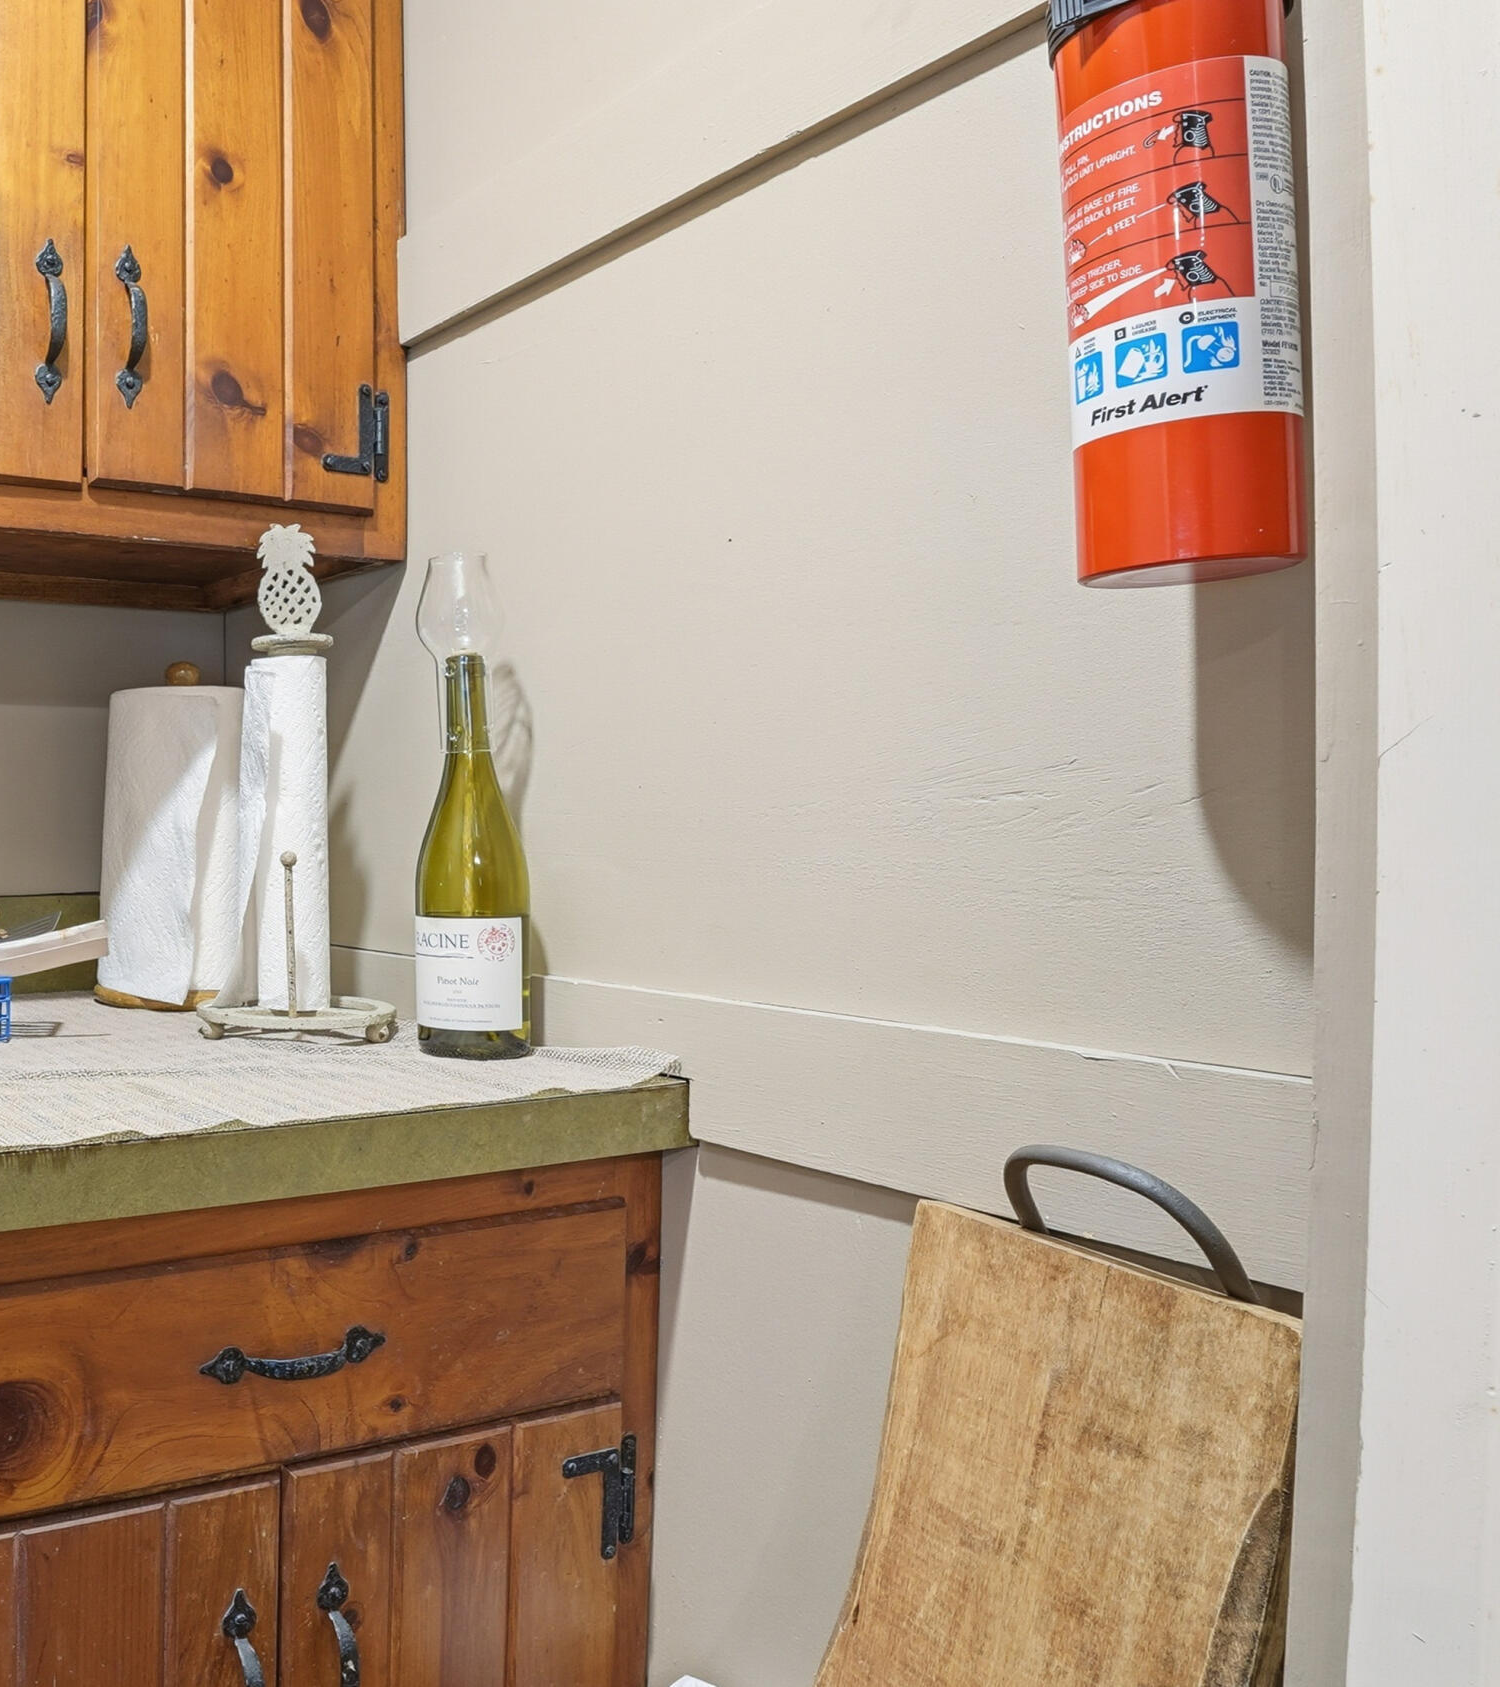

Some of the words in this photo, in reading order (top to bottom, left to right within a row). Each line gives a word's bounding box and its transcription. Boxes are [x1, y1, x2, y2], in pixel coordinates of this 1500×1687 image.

[1083, 197, 1104, 214] BASE
[1104, 190, 1118, 203] OF
[1083, 209, 1106, 226] BACK
[1114, 214, 1137, 232] FEET
[1088, 277, 1106, 291] SIDE
[1107, 272, 1119, 284] TO
[1091, 400, 1137, 427] First
[437, 976, 458, 986] Pinot
[459, 976, 480, 986] Noir
